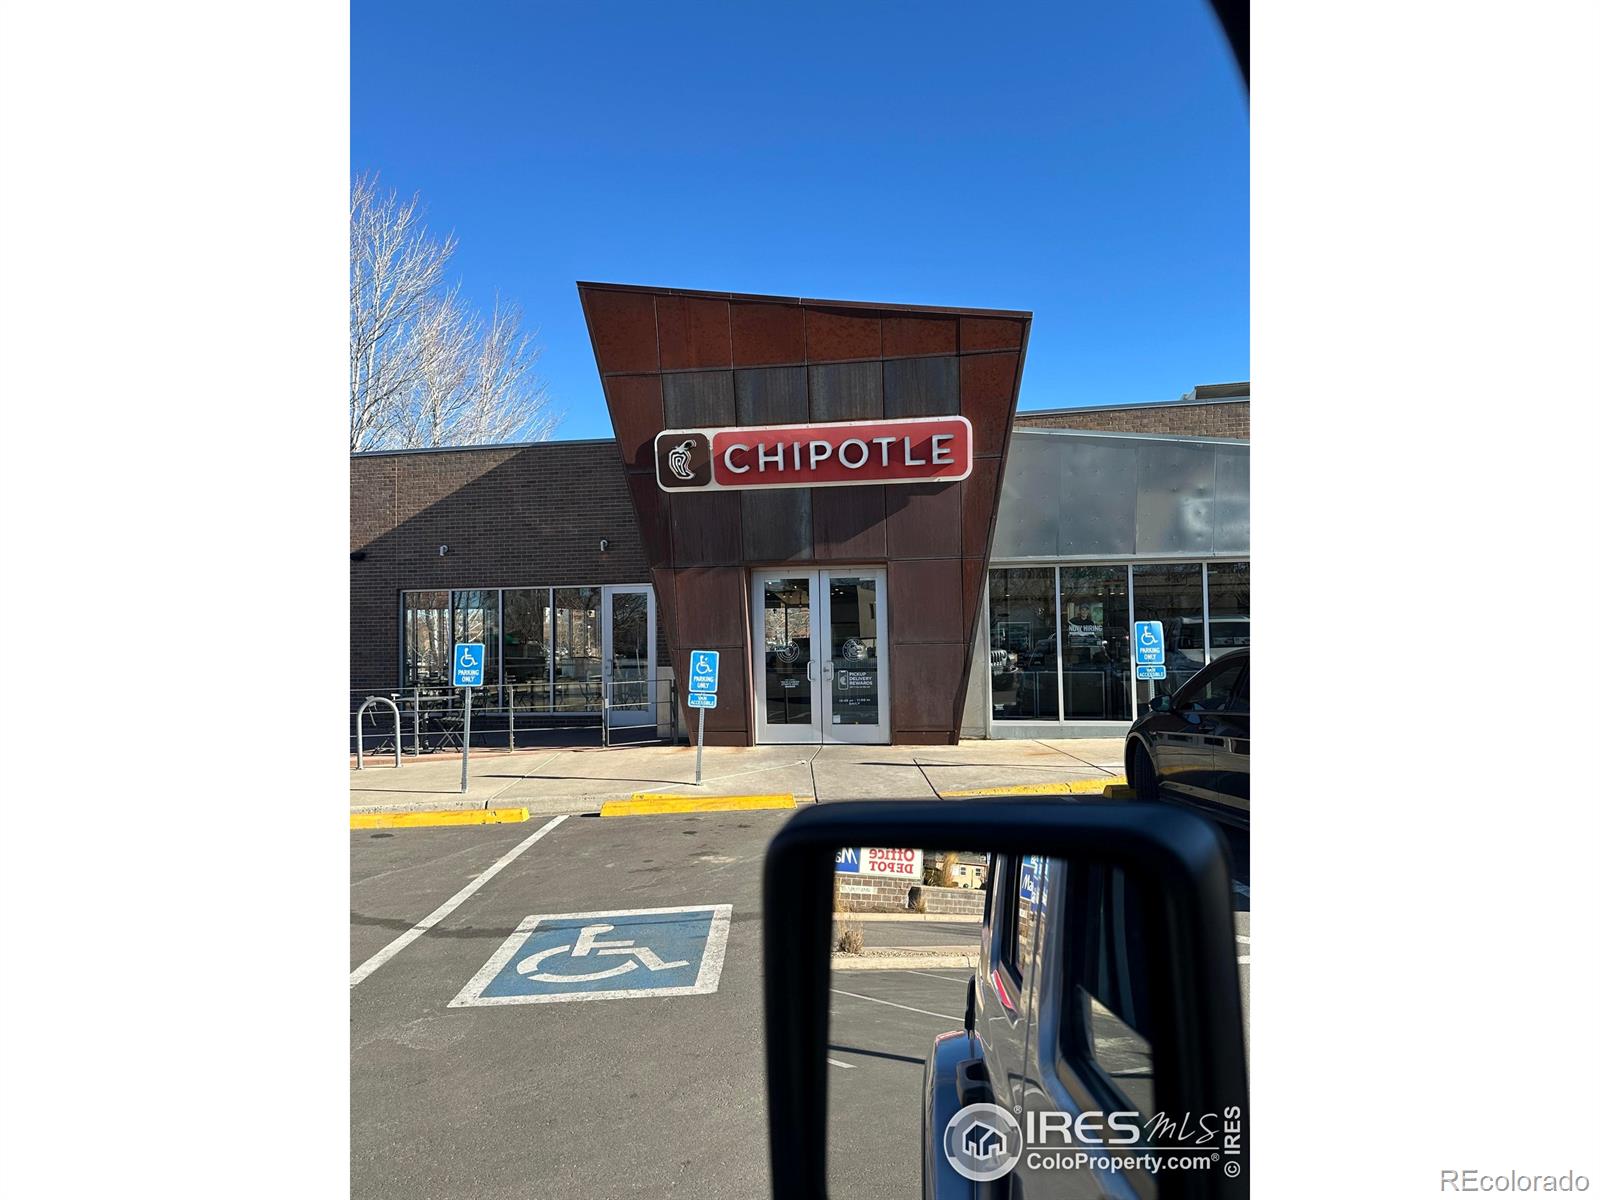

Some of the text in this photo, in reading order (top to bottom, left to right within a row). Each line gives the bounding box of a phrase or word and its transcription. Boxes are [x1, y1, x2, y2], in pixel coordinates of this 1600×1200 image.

[724, 434, 954, 474] CHIPOTLE
[1069, 624, 1103, 632] NOW HIRING
